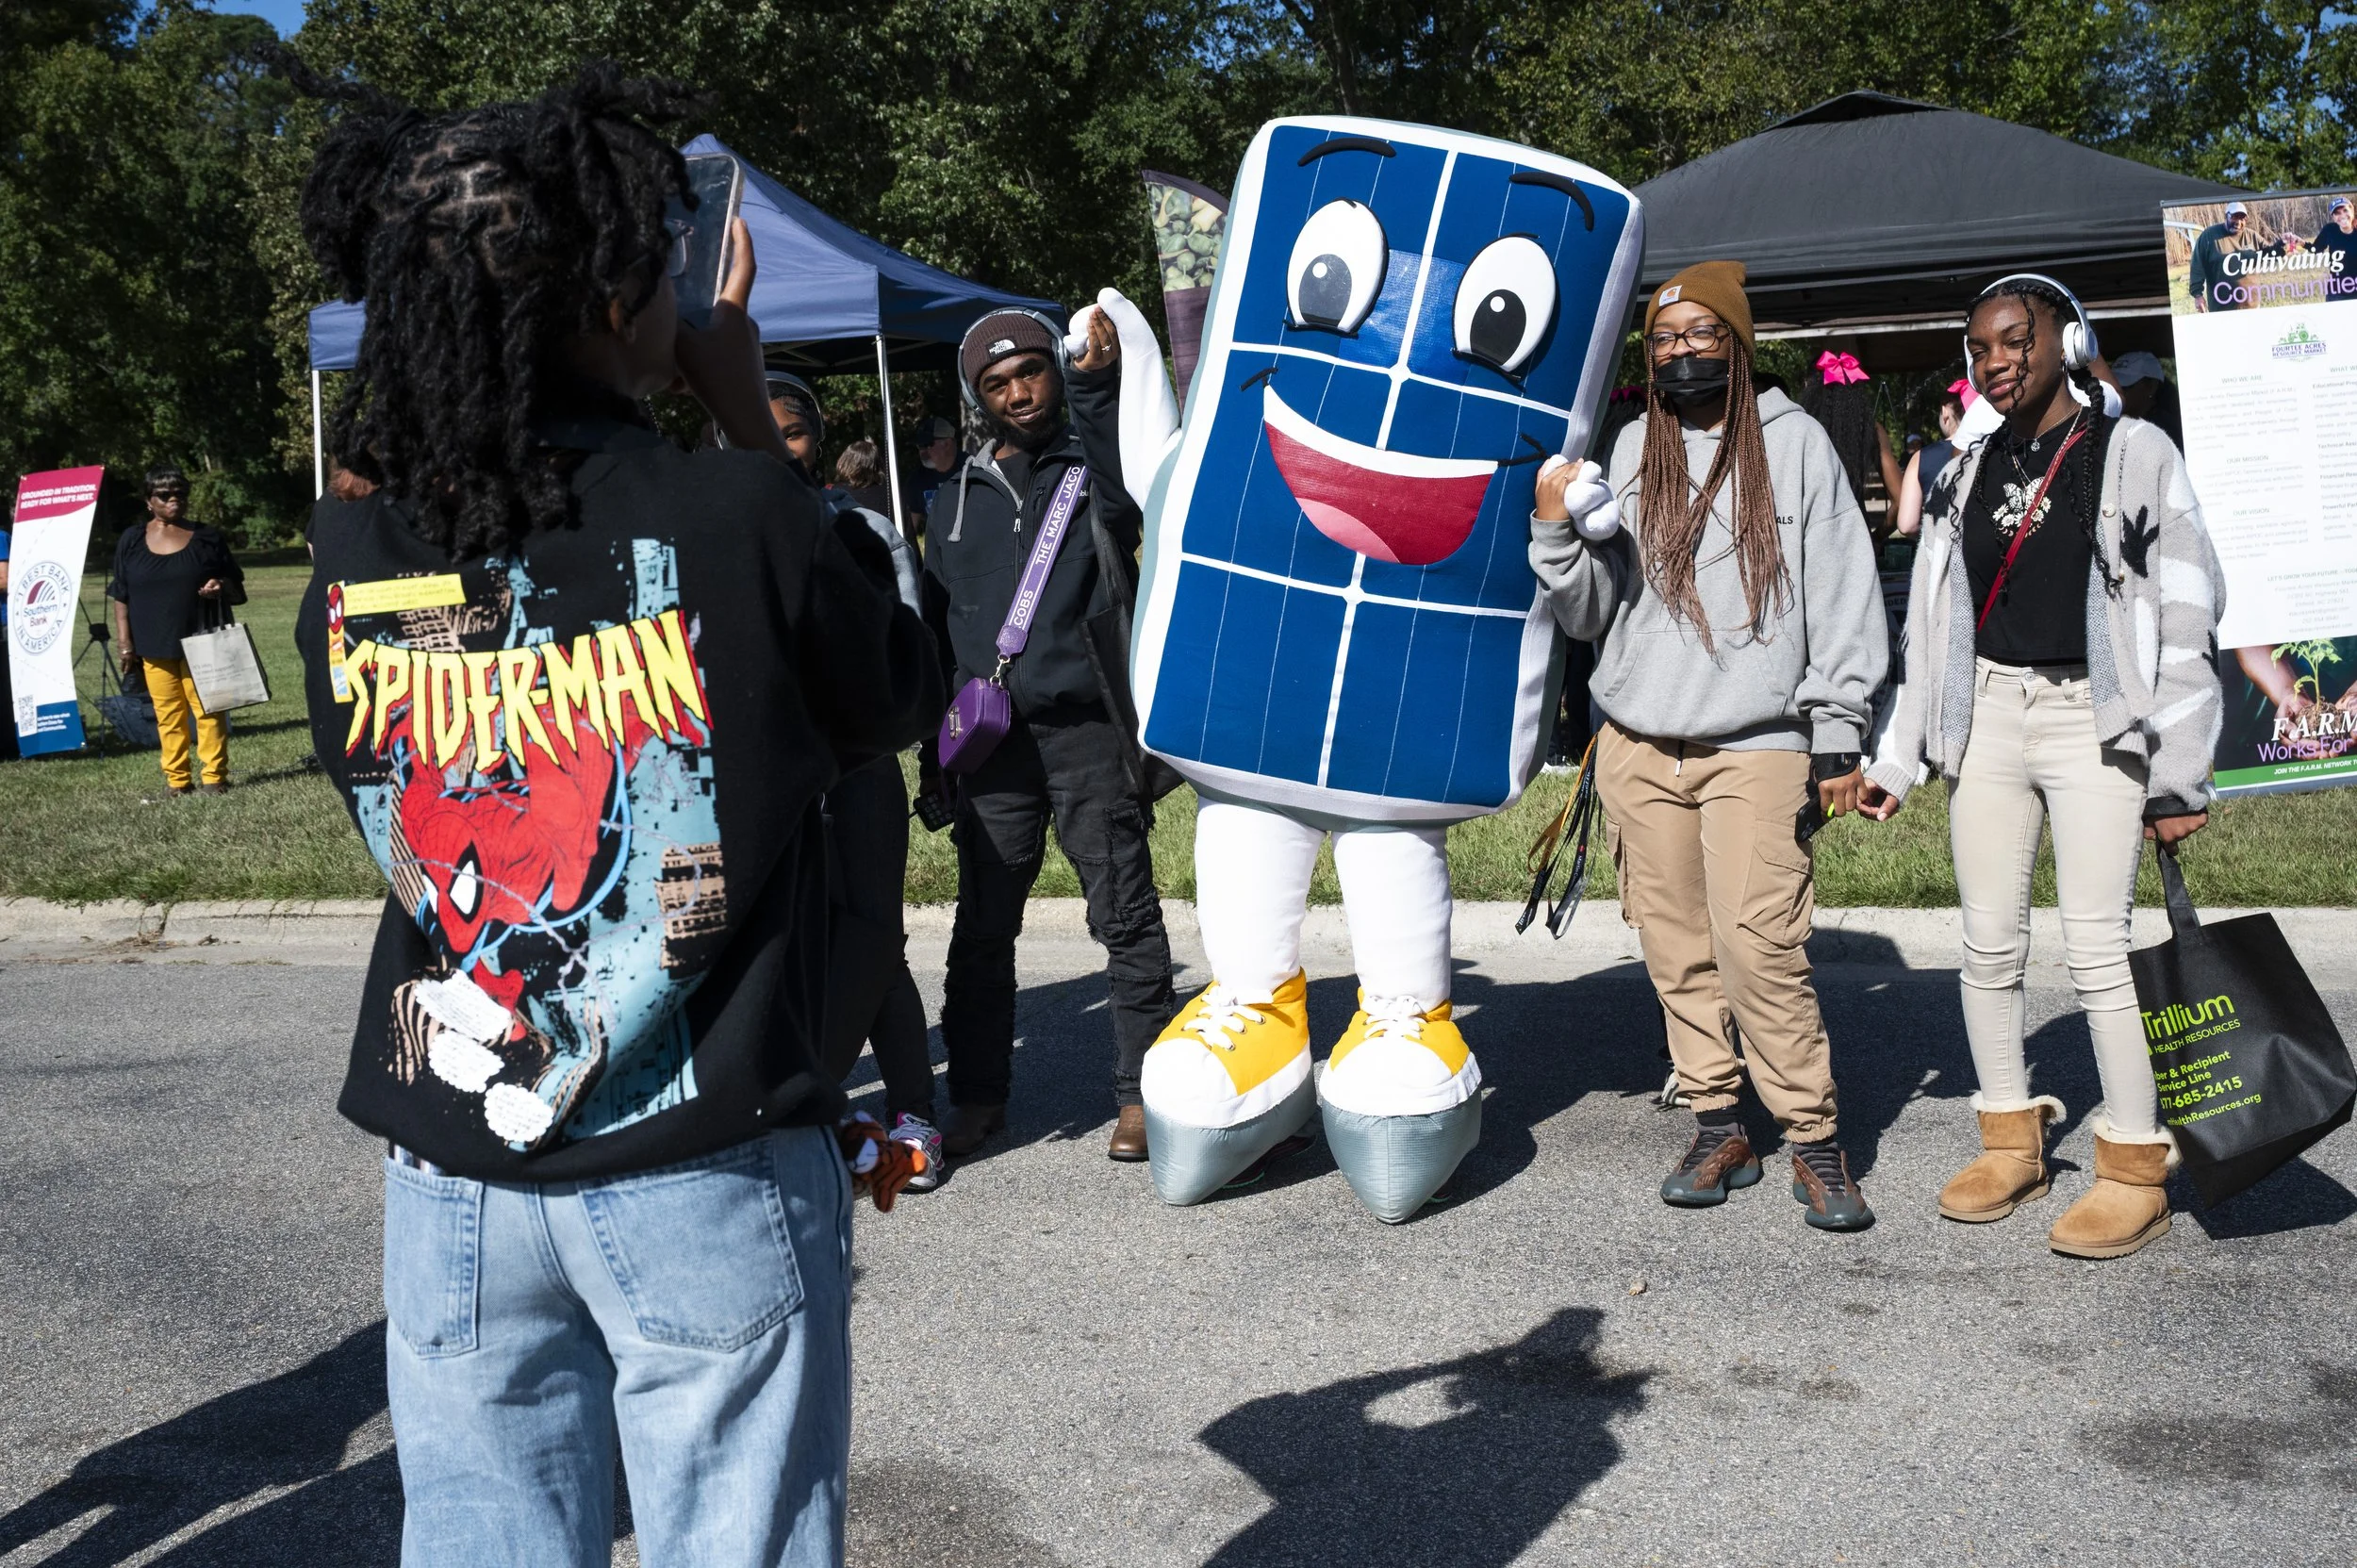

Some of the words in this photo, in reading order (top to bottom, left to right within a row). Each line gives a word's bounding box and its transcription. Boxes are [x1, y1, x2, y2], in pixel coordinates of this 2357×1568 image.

[2223, 247, 2346, 276] Cultivating
[2304, 347, 2327, 355] MARKET
[39, 497, 52, 506] FOR
[1775, 516, 1793, 525] ALS
[1014, 590, 1033, 626] COBS
[1035, 542, 1051, 565] THE
[1047, 503, 1066, 540] MARC
[1063, 463, 1081, 499] JACO
[23, 565, 45, 589] BEST
[48, 566, 69, 592] BANK
[24, 603, 58, 618] Southern
[30, 616, 47, 627] Bank
[25, 619, 62, 651] AMERICA
[345, 609, 711, 773] SPIDER-MAN
[2257, 740, 2316, 762] Works
[2320, 735, 2353, 754] For
[2274, 767, 2287, 775] JOIN
[2324, 760, 2352, 769] NETWORK
[2140, 995, 2235, 1039] Trillium
[2154, 1038, 2184, 1053] HEALTH
[2185, 1019, 2241, 1044] RESOURCES
[2154, 1071, 2167, 1081] ber
[2169, 1068, 2179, 1079] &
[2180, 1050, 2232, 1074] Recipient
[2157, 1080, 2187, 1092] Service
[2188, 1071, 2212, 1084] Line
